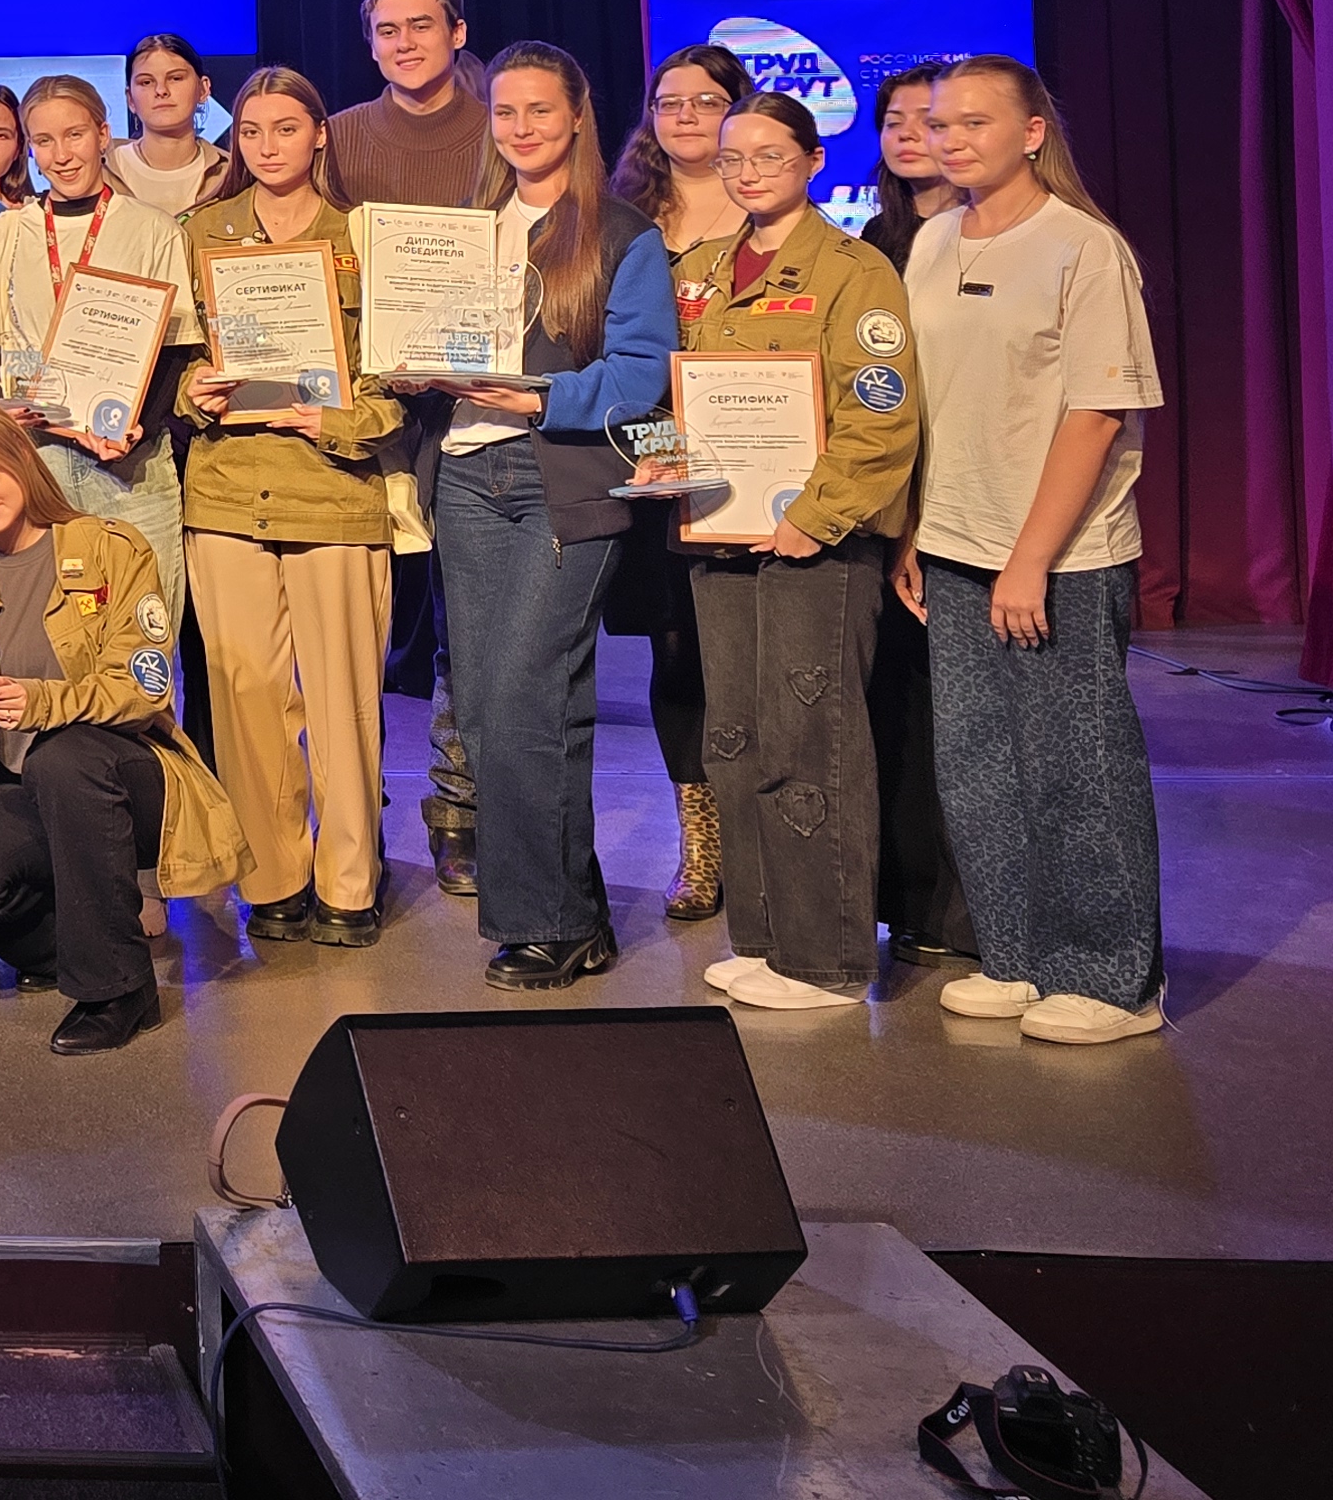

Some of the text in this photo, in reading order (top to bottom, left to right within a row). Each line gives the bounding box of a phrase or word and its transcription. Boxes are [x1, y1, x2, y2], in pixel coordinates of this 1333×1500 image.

[405, 236, 455, 248] ДИПЛОМ
[395, 245, 465, 258] ПОБЕДИТЕЛЯ
[235, 283, 307, 296] СЕРТИФИКАТ
[82, 307, 141, 326] СЕРТИФИКАТ
[708, 394, 789, 404] СЕРТИФИКАТ
[621, 420, 677, 440] ТРУД
[634, 435, 689, 456] КРУТ
